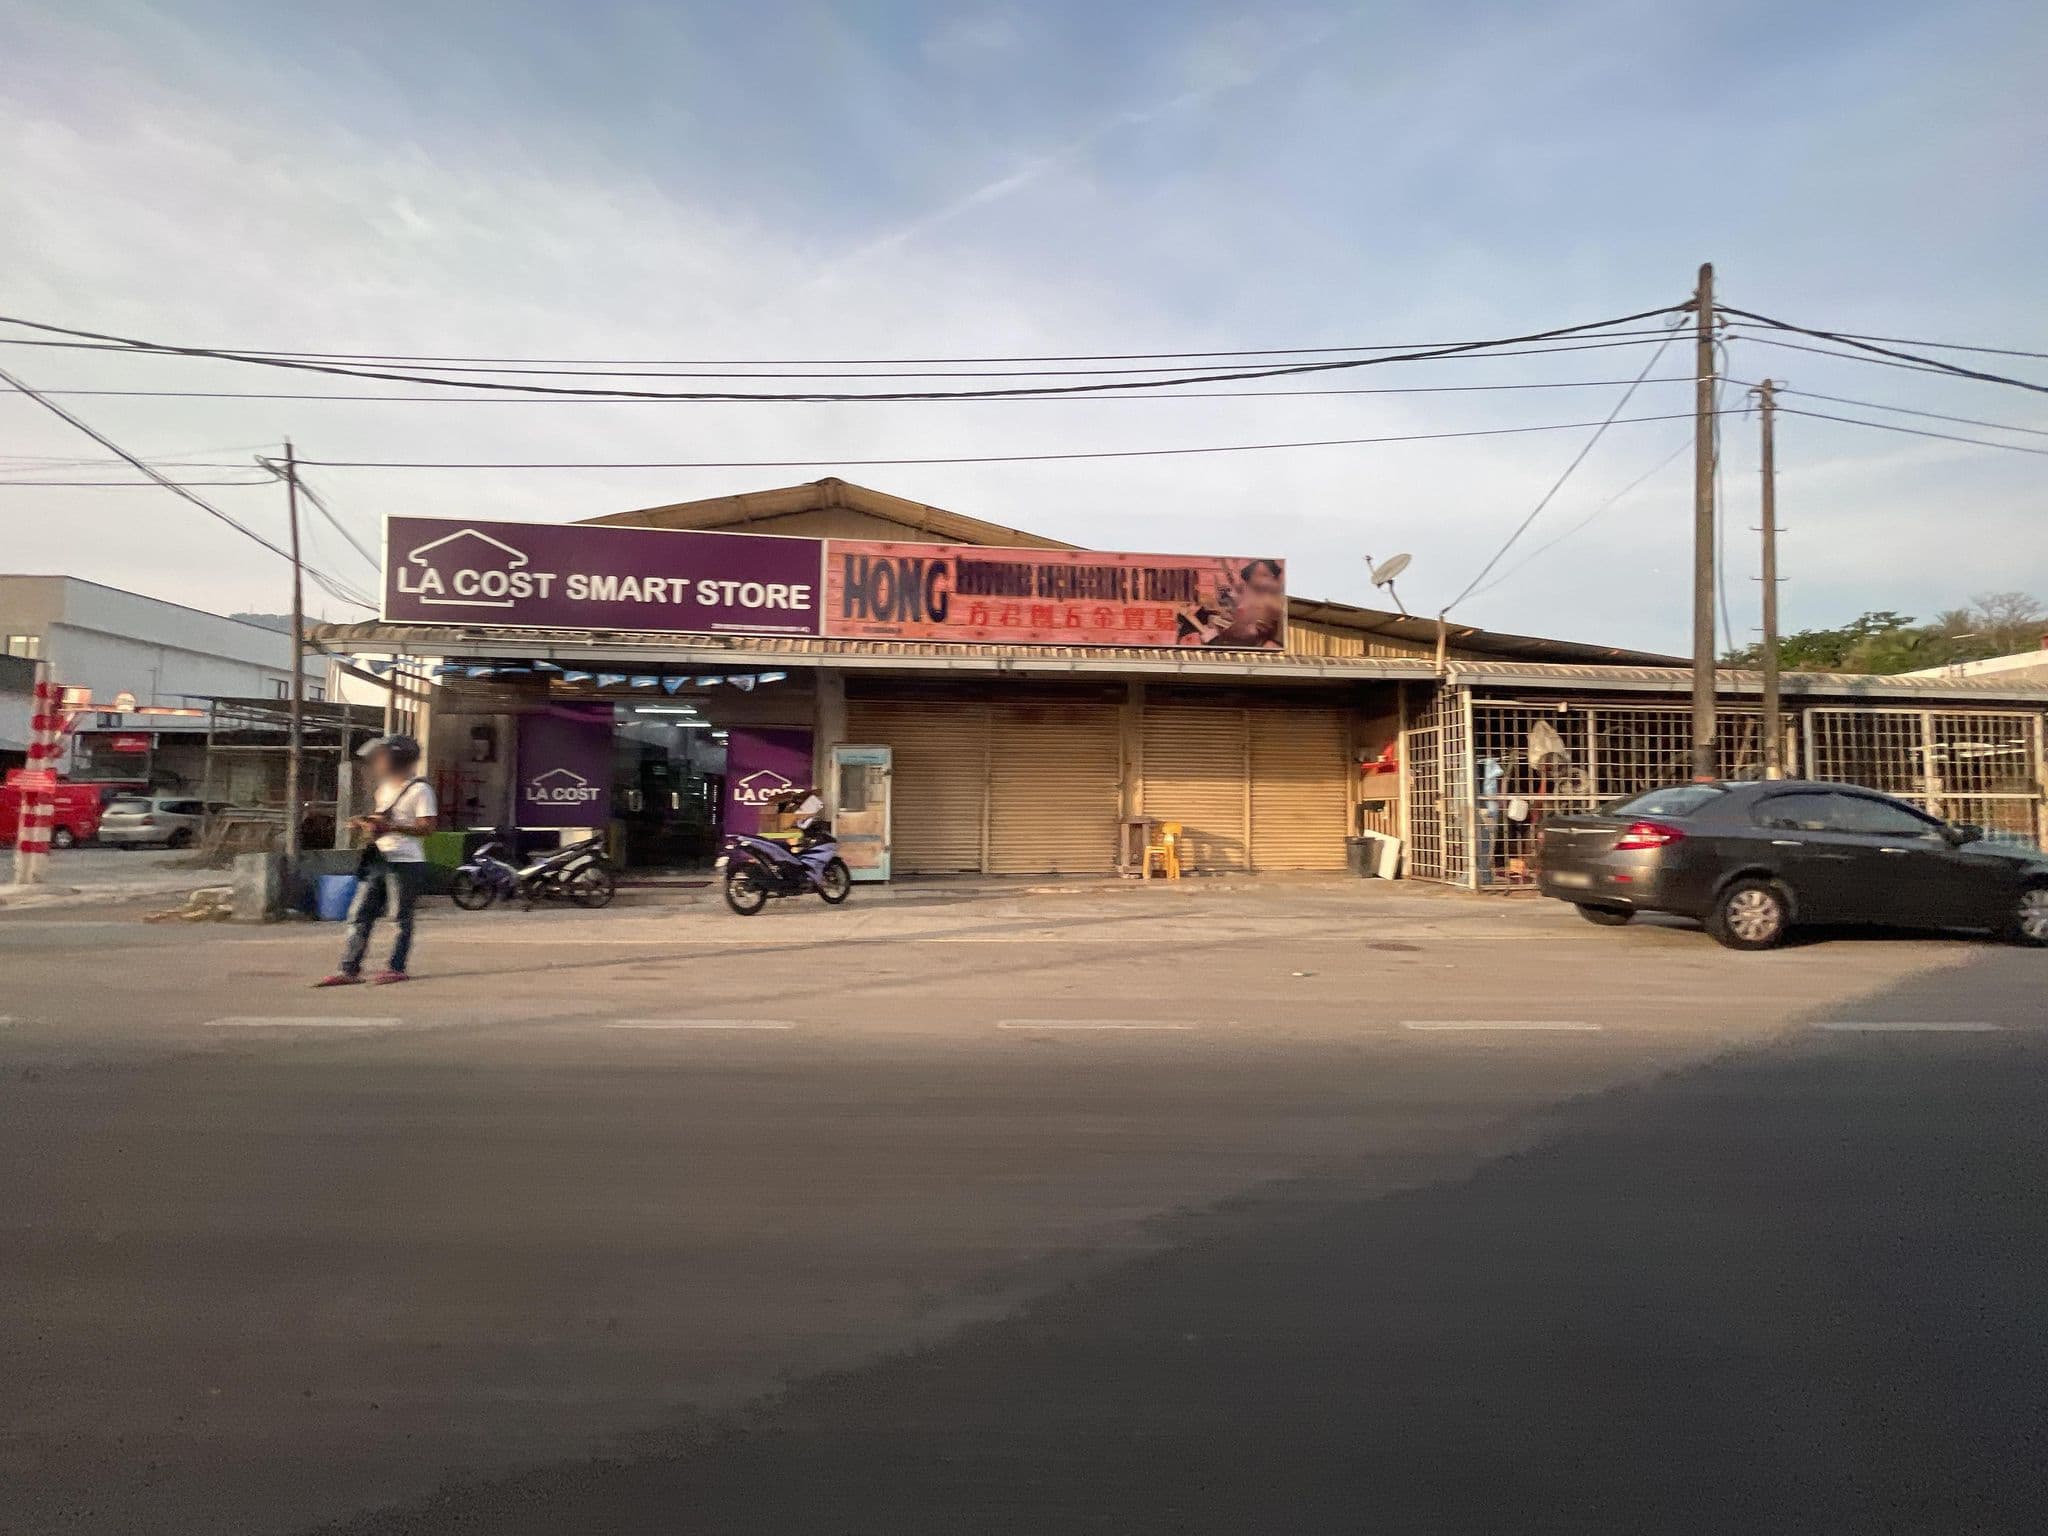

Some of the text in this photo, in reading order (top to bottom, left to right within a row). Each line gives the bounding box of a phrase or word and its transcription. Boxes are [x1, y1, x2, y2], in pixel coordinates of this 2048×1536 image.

[398, 566, 811, 610] LA COST SMART STORE
[843, 553, 948, 623] HONG
[527, 788, 601, 801] LA COST
[734, 788, 756, 801] LA
